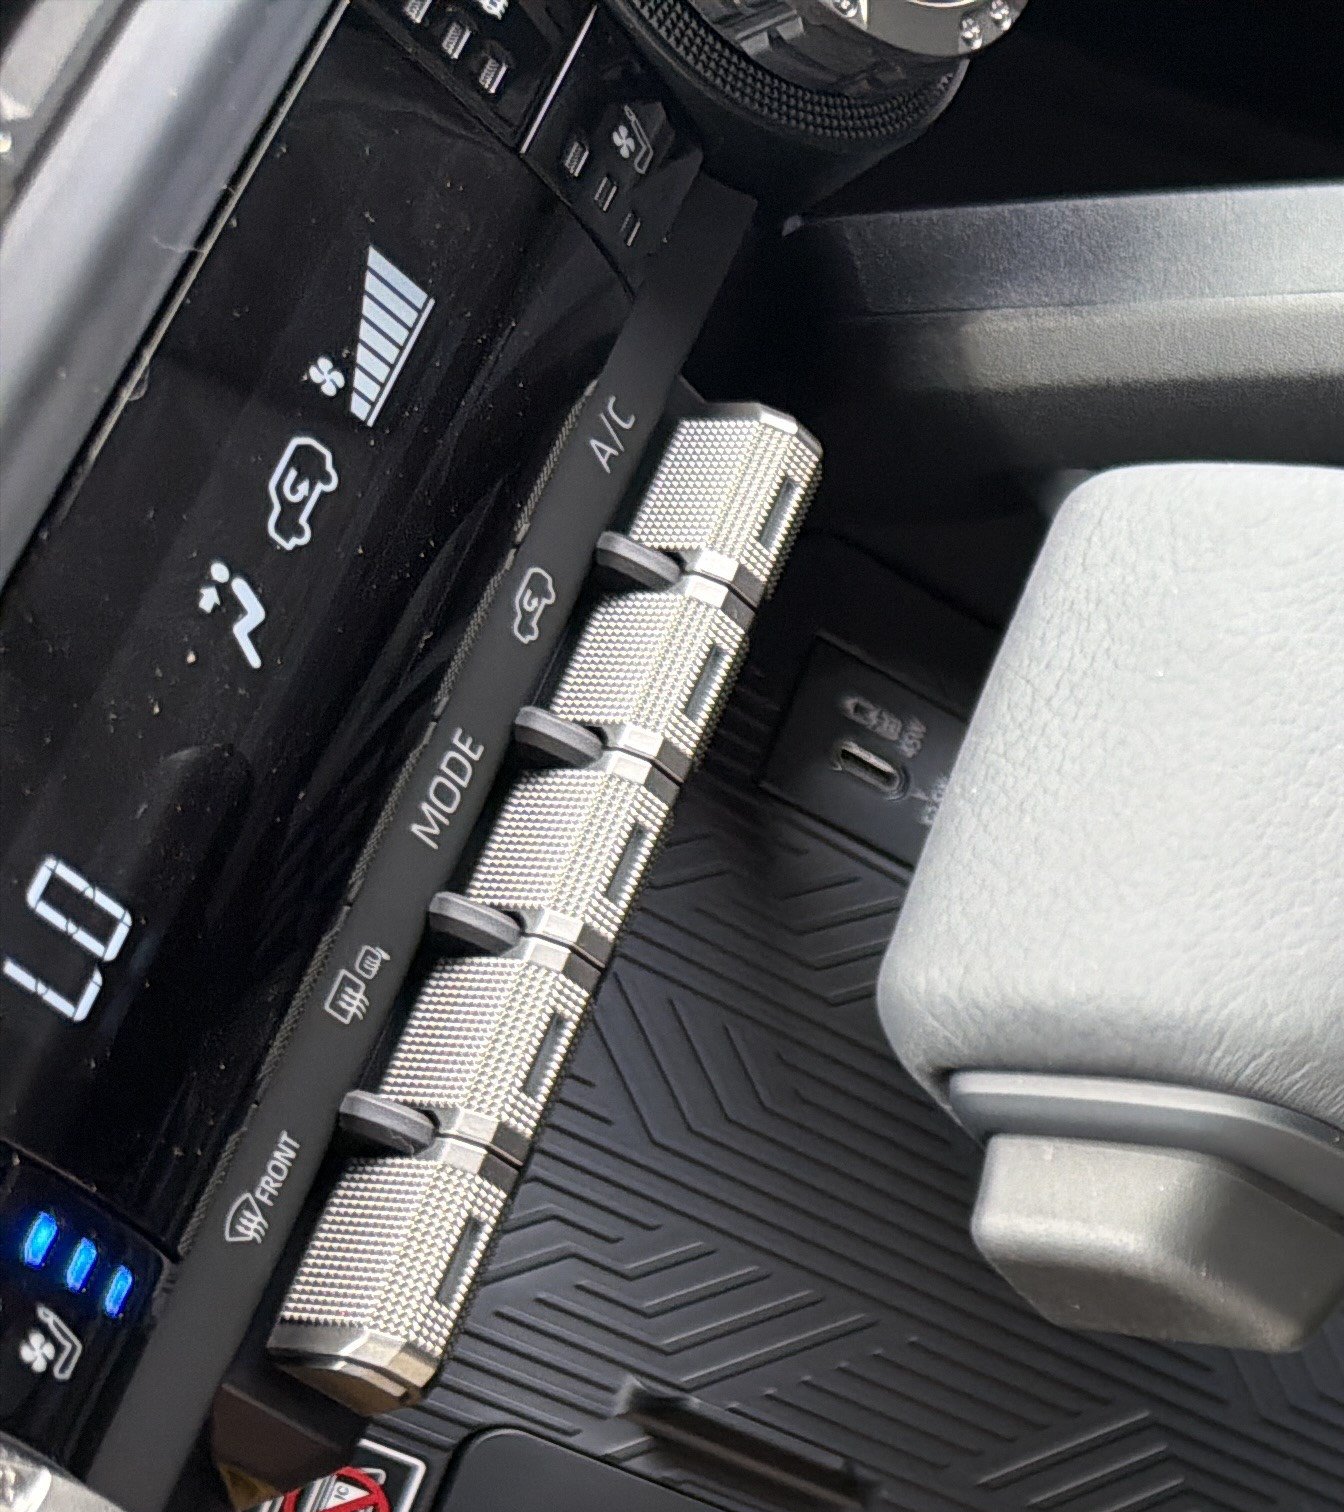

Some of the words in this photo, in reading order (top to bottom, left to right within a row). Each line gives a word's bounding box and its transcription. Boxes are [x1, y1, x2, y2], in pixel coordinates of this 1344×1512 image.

[589, 395, 636, 474] A/C
[410, 727, 485, 850] MODE
[254, 1130, 300, 1206] FRONT
